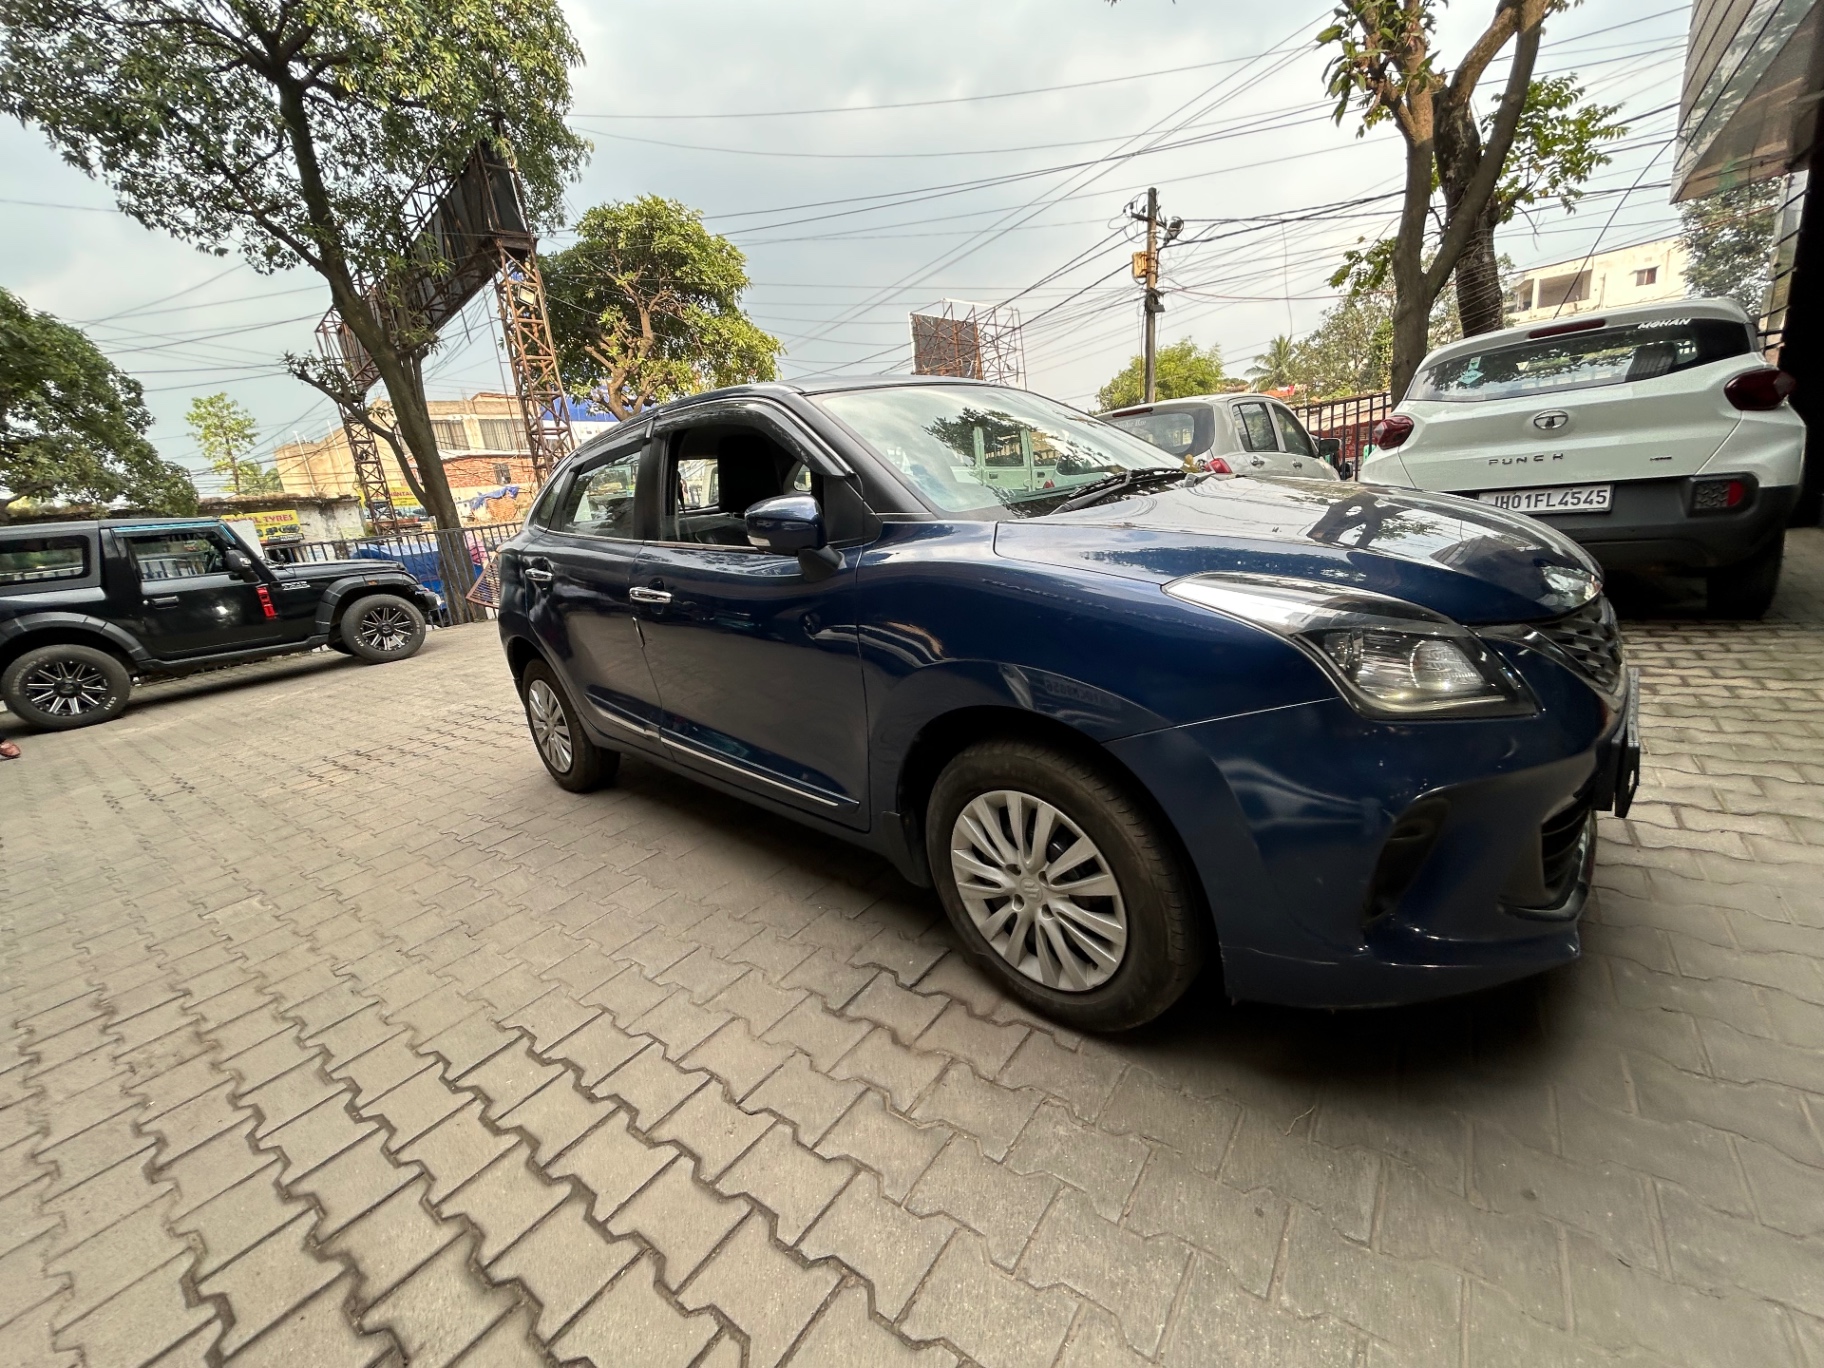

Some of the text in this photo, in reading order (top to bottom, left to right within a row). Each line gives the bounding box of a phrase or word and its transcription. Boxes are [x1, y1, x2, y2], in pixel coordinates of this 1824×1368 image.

[1637, 318, 1692, 330] MOHAN
[1489, 453, 1564, 466] PUNCH
[263, 514, 294, 522] TYRES
